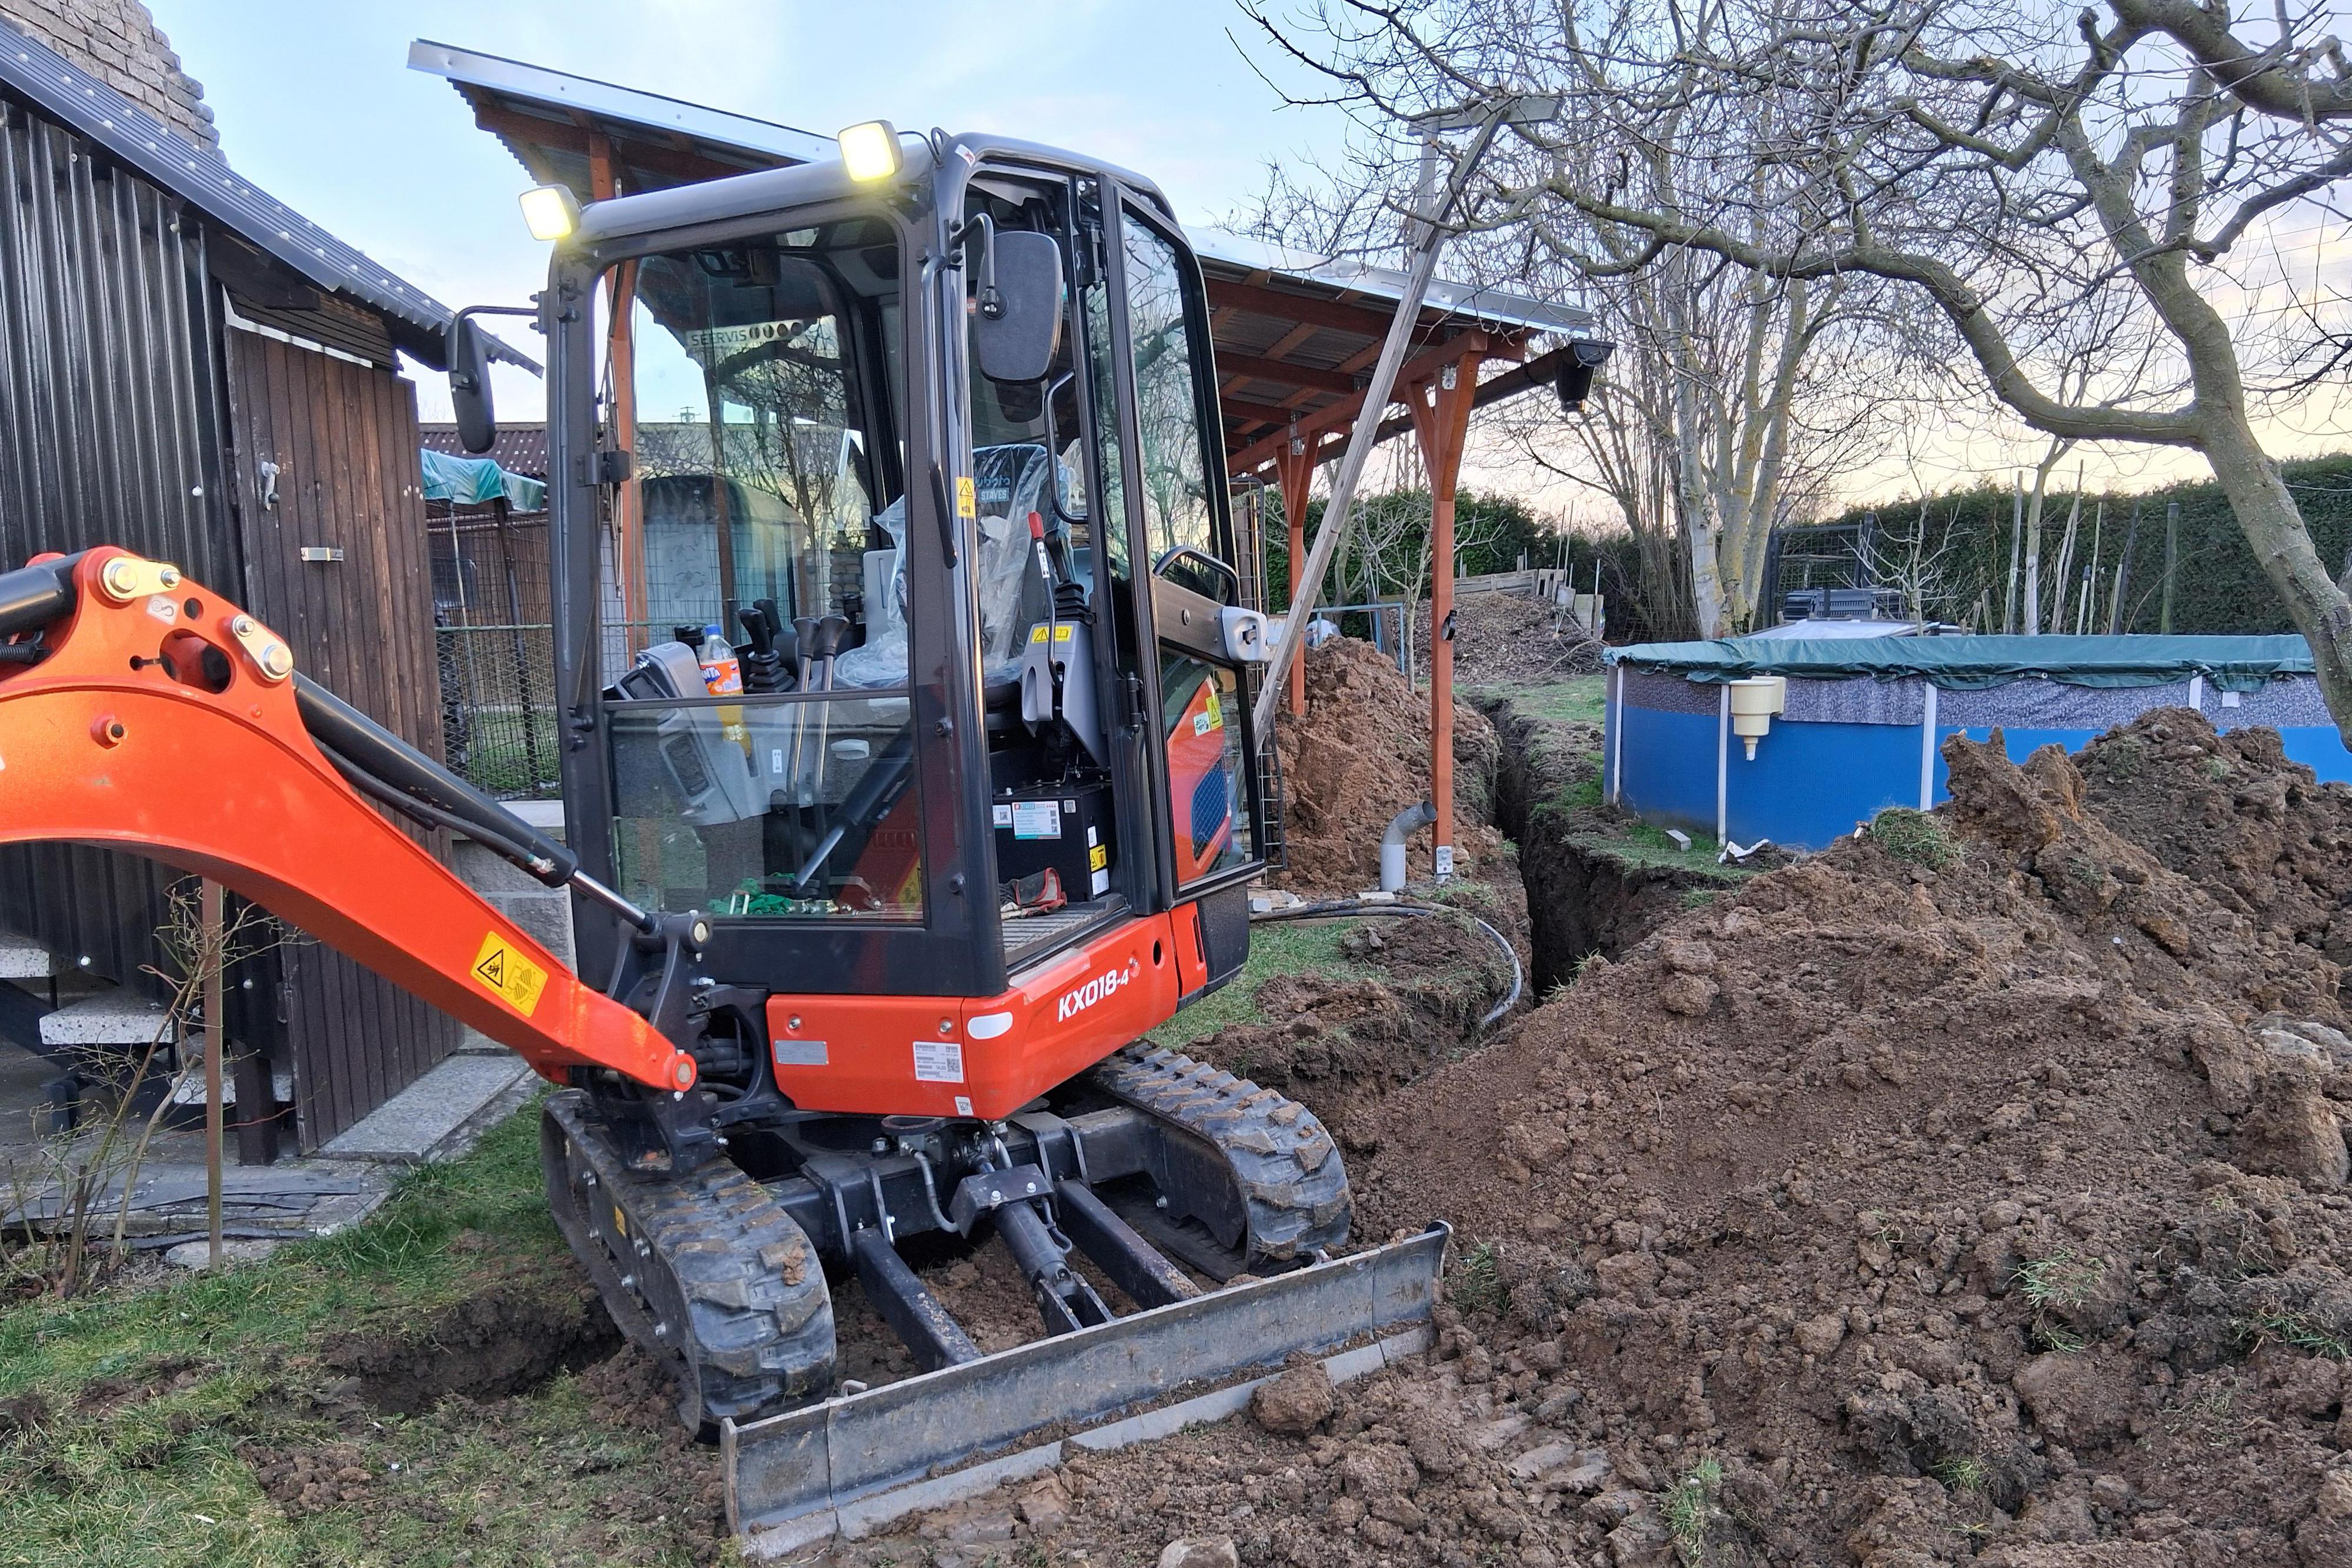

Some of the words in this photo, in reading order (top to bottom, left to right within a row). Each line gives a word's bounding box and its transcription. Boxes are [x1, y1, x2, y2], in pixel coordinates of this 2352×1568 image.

[975, 474, 1011, 487] ubota
[981, 489, 1007, 501] STAVES
[1058, 968, 1129, 1023] KX018-4
